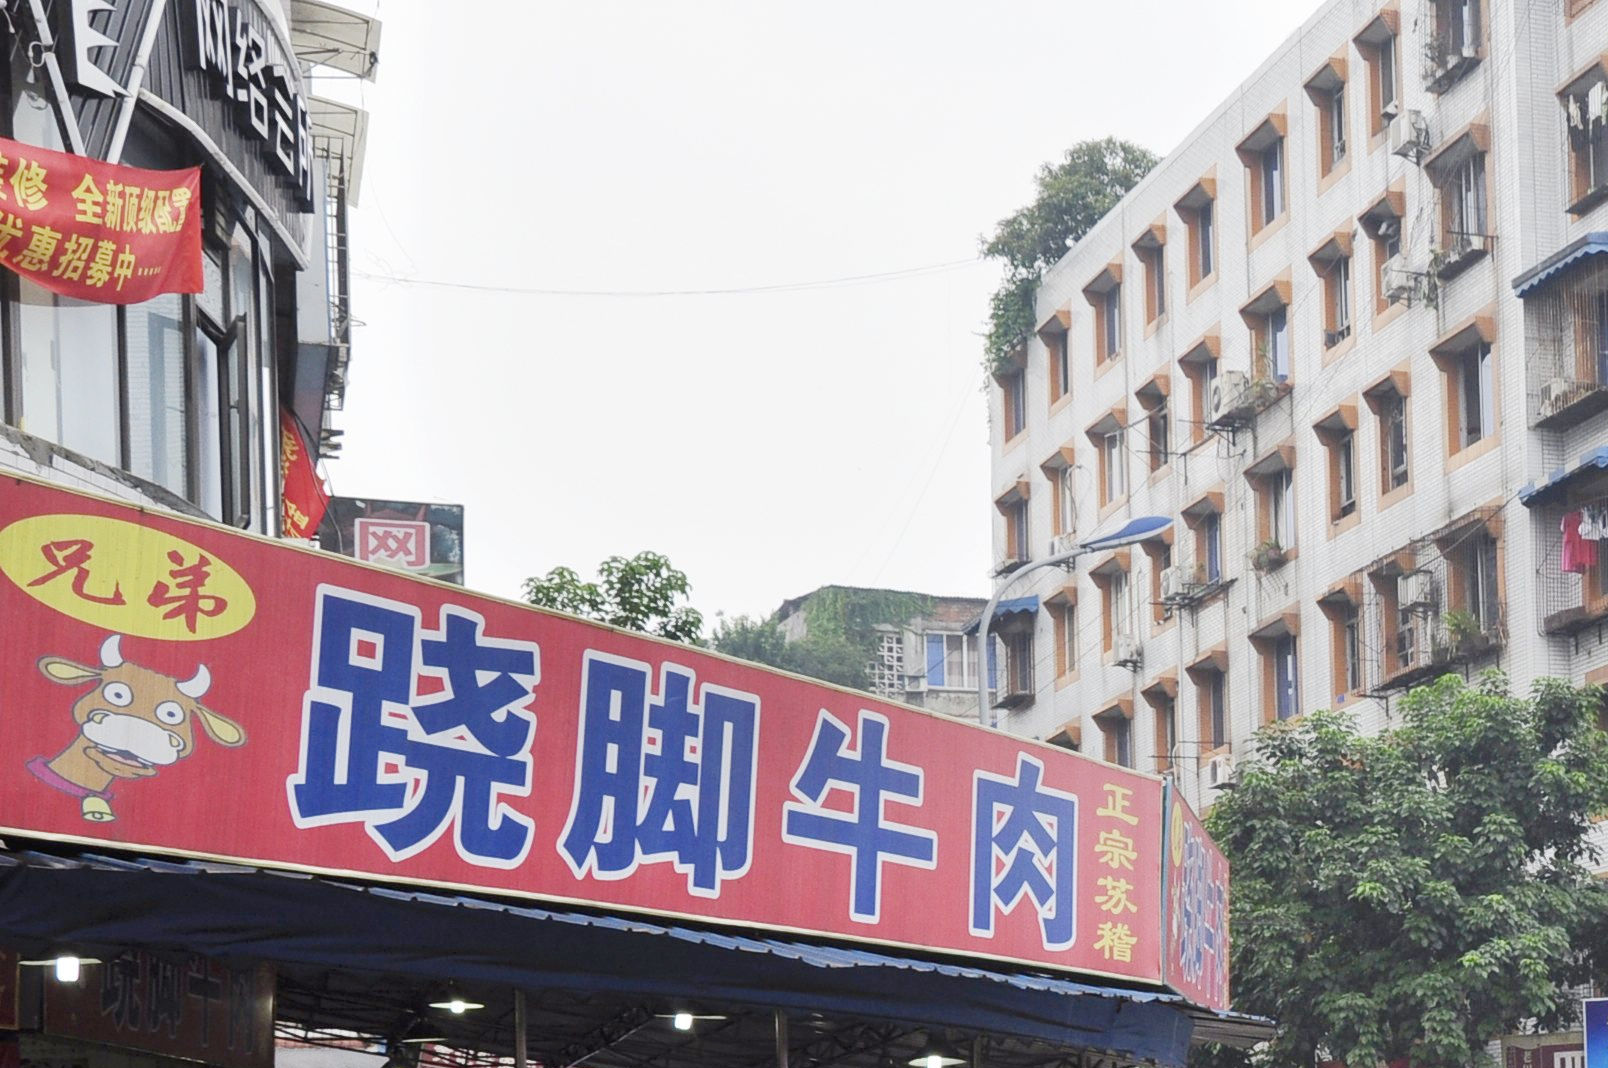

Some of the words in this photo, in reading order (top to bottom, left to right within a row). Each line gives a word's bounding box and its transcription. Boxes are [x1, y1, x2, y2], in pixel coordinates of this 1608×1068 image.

[26, 538, 228, 633] 兄弟
[287, 583, 1079, 951] 跷脚牛肉
[1093, 783, 1139, 963] 正宗苏稽
